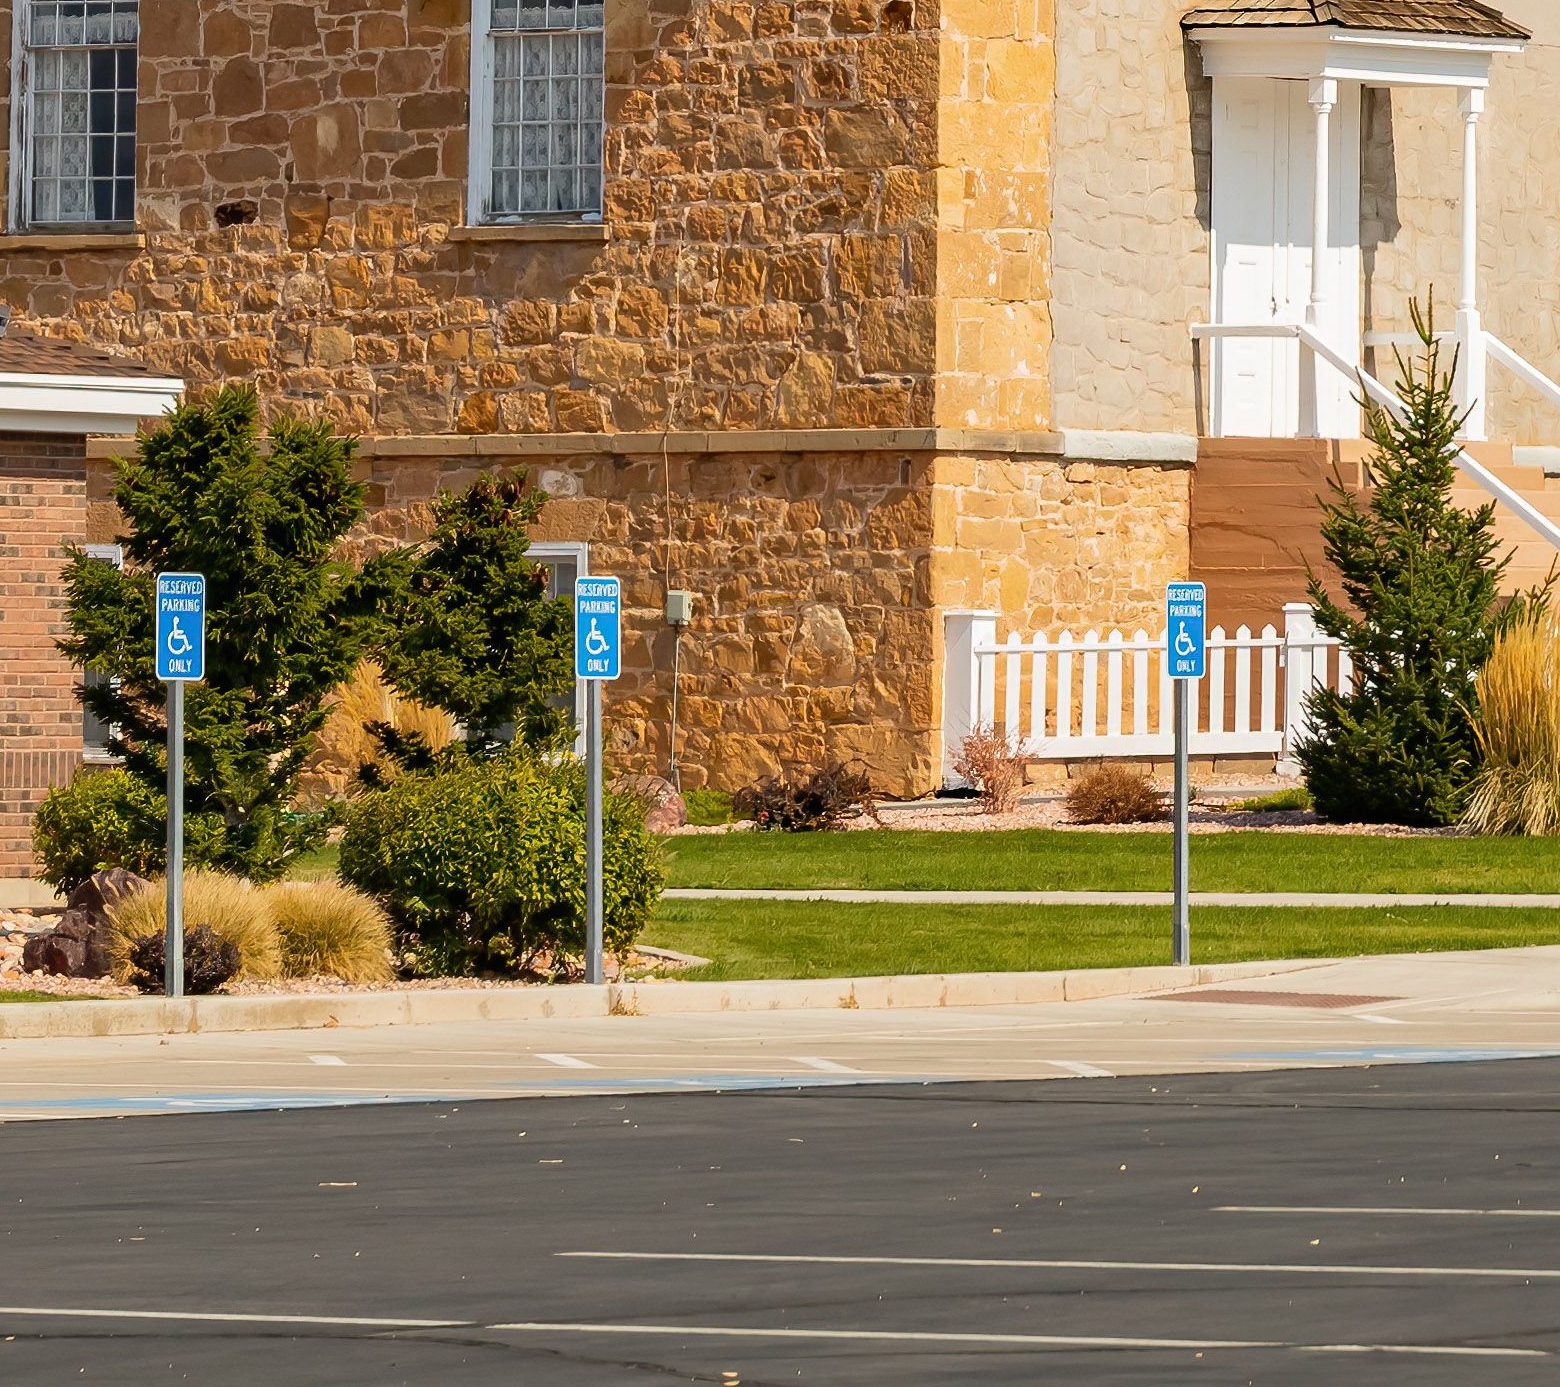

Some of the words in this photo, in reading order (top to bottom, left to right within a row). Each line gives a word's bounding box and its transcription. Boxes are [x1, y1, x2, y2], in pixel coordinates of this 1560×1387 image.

[160, 580, 203, 594] RESERVED
[578, 583, 617, 596] RESERVED
[1168, 588, 1204, 601] RESERVED
[161, 598, 201, 611] PARKING
[580, 600, 616, 613] PARKING
[1169, 604, 1202, 617] PARKING
[168, 658, 192, 672] ONLY
[587, 658, 609, 672] ONLY
[1176, 658, 1196, 672] ONLY
